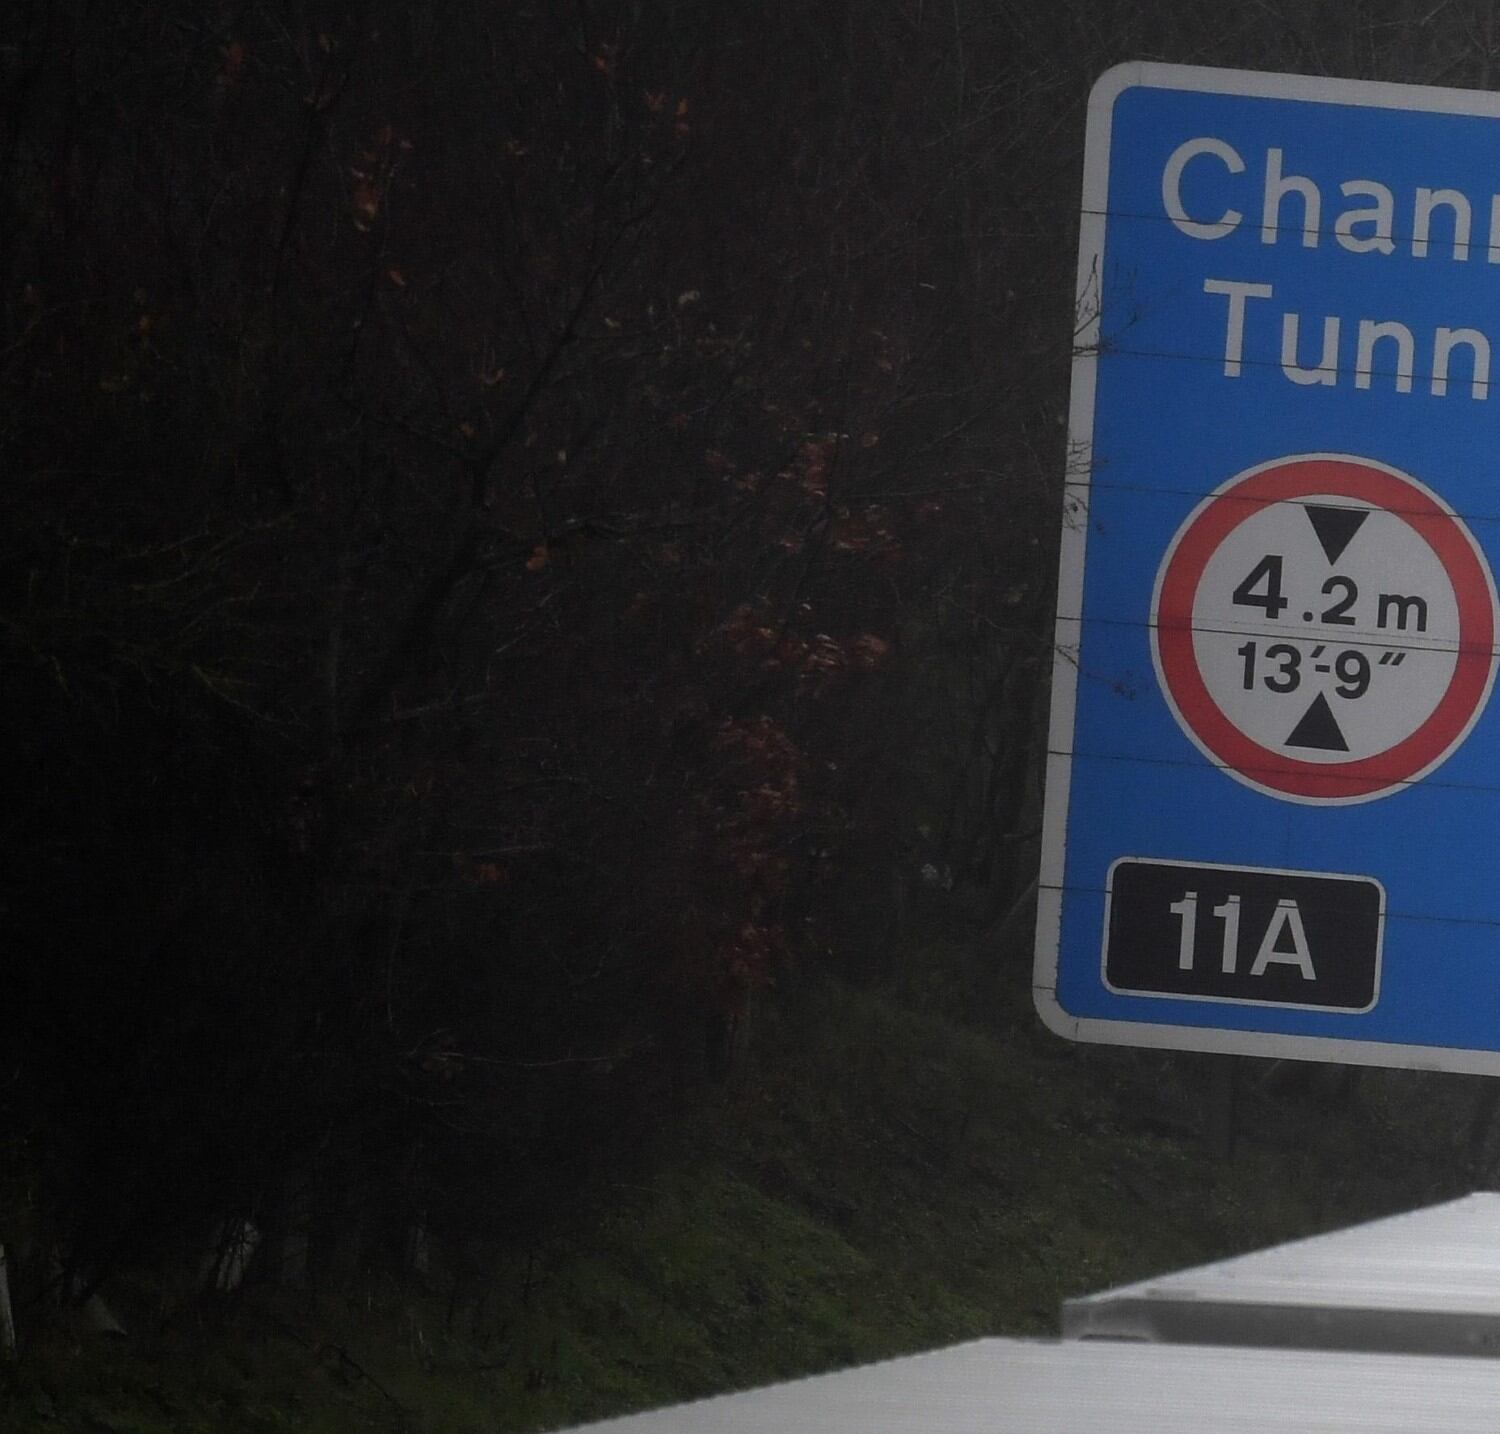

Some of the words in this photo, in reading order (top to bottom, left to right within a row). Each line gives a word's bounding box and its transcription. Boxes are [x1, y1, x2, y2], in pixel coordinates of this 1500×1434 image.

[1232, 554, 1359, 626] 4.2
[1376, 593, 1428, 633] m
[1168, 894, 1317, 981] 11A
